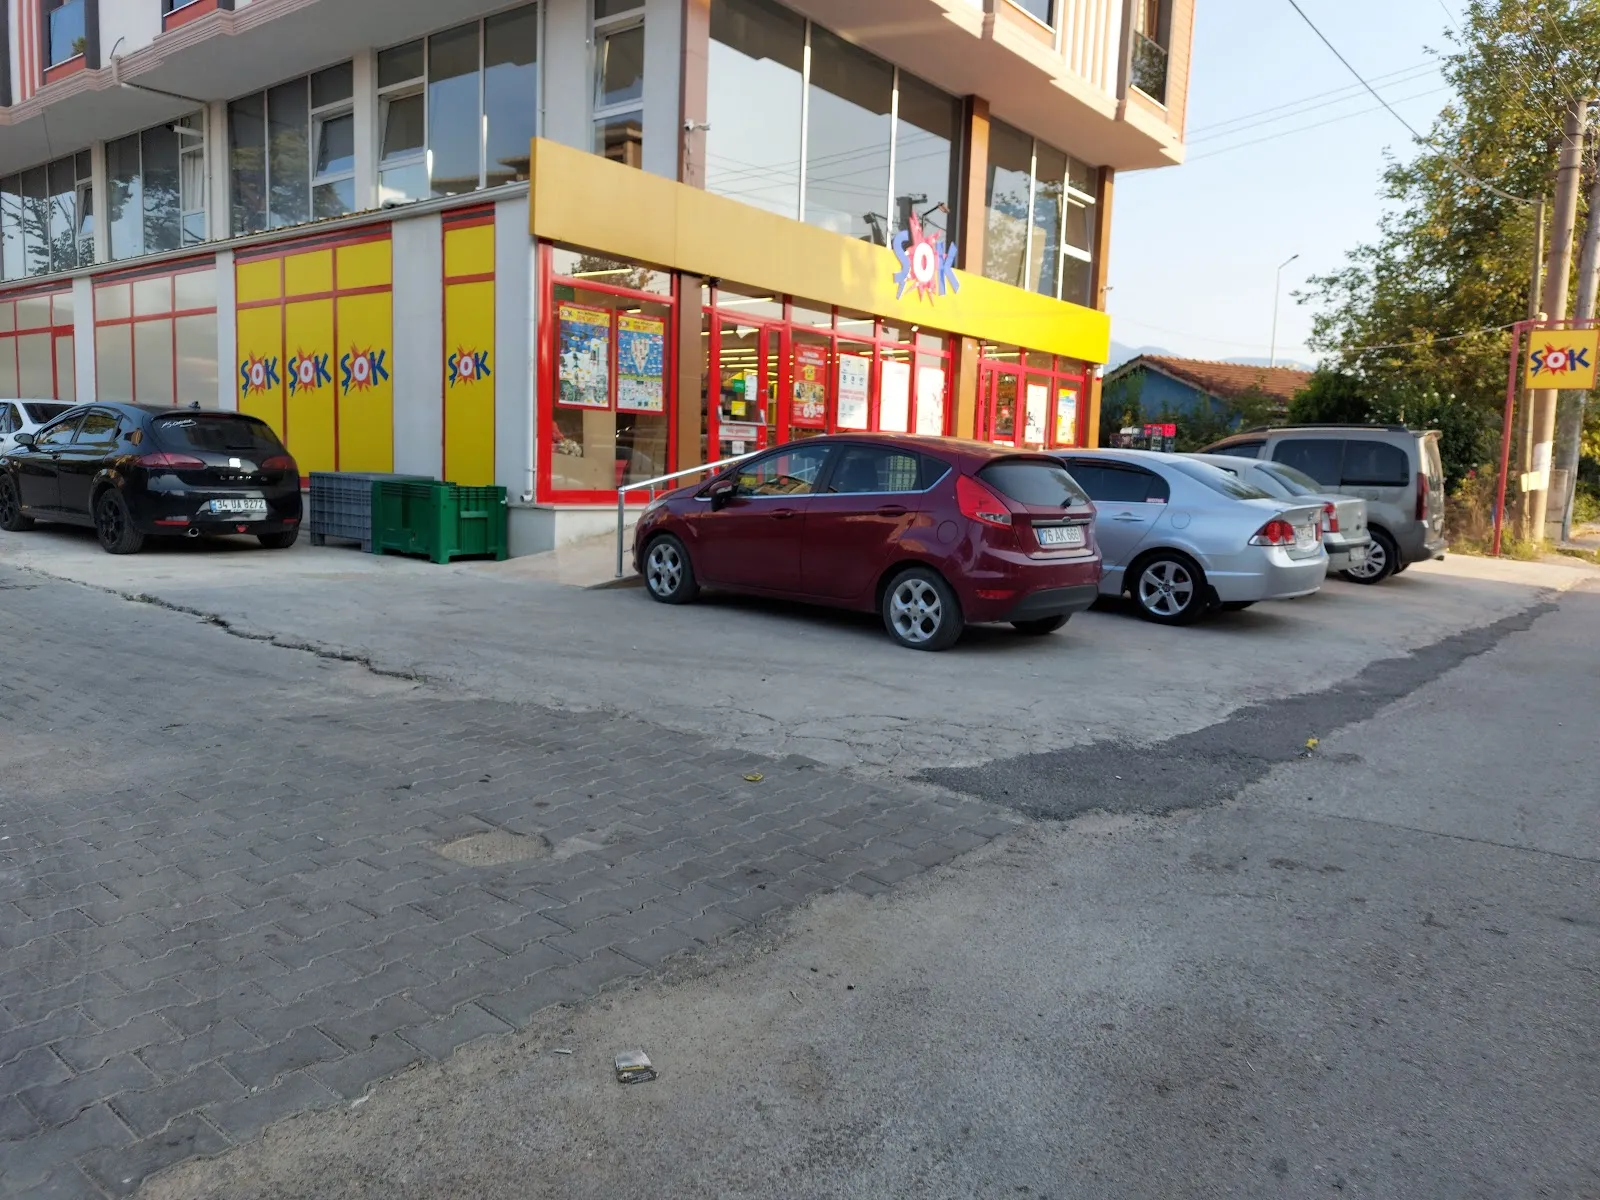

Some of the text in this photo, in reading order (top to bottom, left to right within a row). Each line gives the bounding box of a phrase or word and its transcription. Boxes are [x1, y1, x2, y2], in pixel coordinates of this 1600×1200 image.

[892, 229, 960, 300] ŞOK
[240, 356, 280, 399] ŞOK
[288, 353, 332, 397] ŞOK
[340, 349, 389, 396] ŞOK
[448, 350, 491, 388] ŞOK
[1530, 347, 1591, 378] ŞOK
[216, 499, 228, 509] 34
[1043, 529, 1054, 542] 76
[1055, 527, 1067, 541] AK
